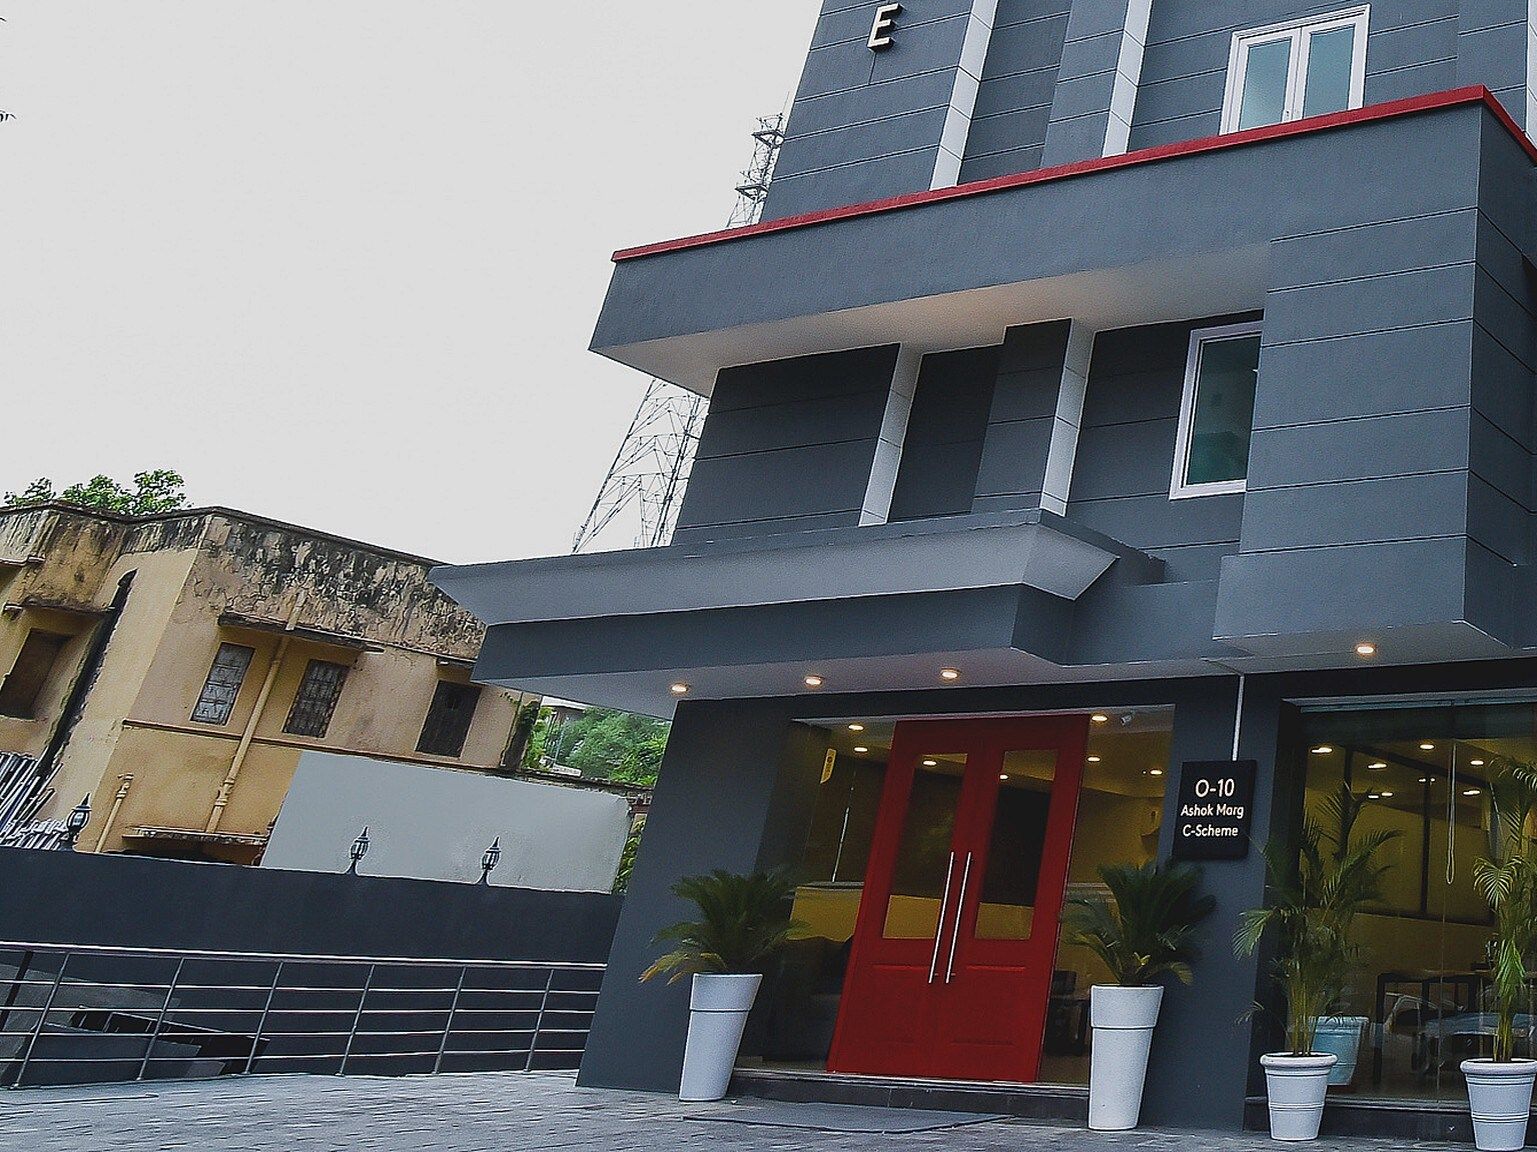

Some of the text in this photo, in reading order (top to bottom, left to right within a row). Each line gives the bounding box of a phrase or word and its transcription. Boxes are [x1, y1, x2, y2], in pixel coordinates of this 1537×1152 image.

[1195, 779, 1235, 797] O-10
[1181, 804, 1244, 819] Ashok Marg
[1182, 824, 1238, 836] C-Scheme
